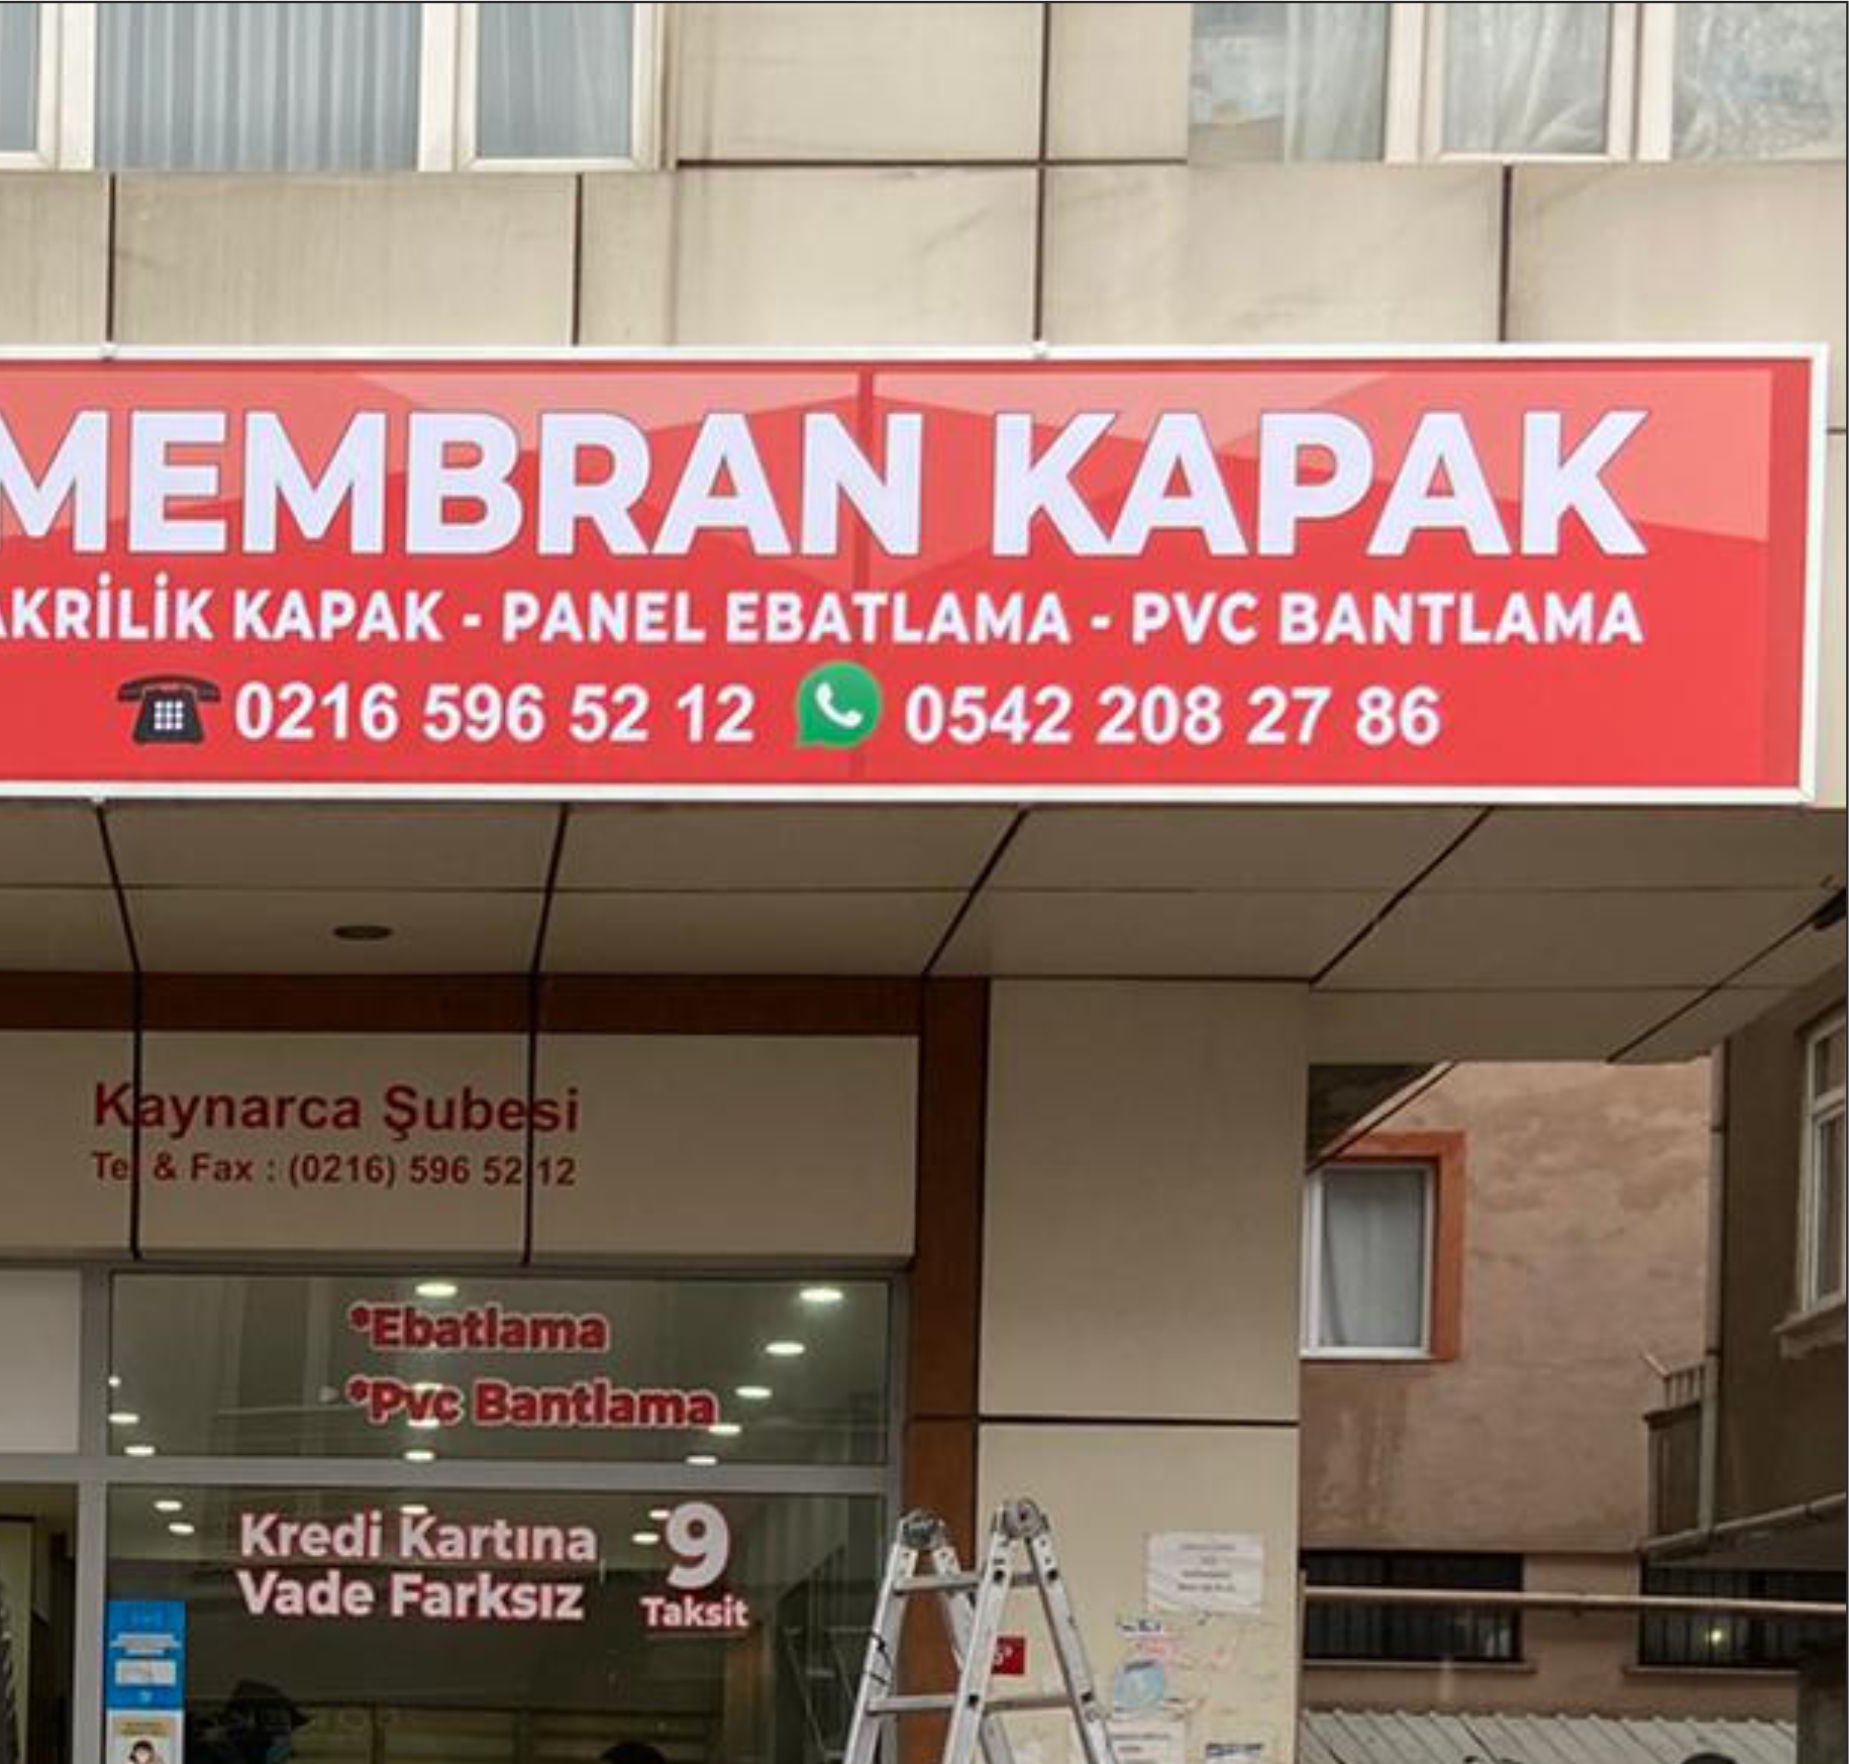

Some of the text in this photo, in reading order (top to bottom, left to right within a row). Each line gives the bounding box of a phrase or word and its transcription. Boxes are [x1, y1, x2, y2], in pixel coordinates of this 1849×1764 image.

[991, 410, 1650, 558] KAPAK
[234, 588, 445, 642] KAPAK
[502, 589, 707, 643] PANEL
[725, 590, 1071, 645] EBATLAMA
[1132, 591, 1260, 645] PVC
[1279, 591, 1645, 645] BANTLAMA
[234, 681, 1441, 745] 0216 596 52 12 0542 208 27 86
[95, 1081, 580, 1142] Kaynarca Şubesi
[92, 1151, 139, 1181] Te
[153, 1152, 176, 1181] &
[191, 1152, 254, 1181] Fax
[288, 1153, 397, 1187] (0216)
[409, 1155, 470, 1185] 596
[483, 1156, 523, 1186] 52
[538, 1156, 576, 1187] 12
[474, 1380, 719, 1428] Bantlama
[238, 1511, 598, 1562] Kredi Kartına
[664, 1501, 731, 1590] 9
[237, 1569, 585, 1621] Vade Farksız
[639, 1595, 750, 1630] Taksit
